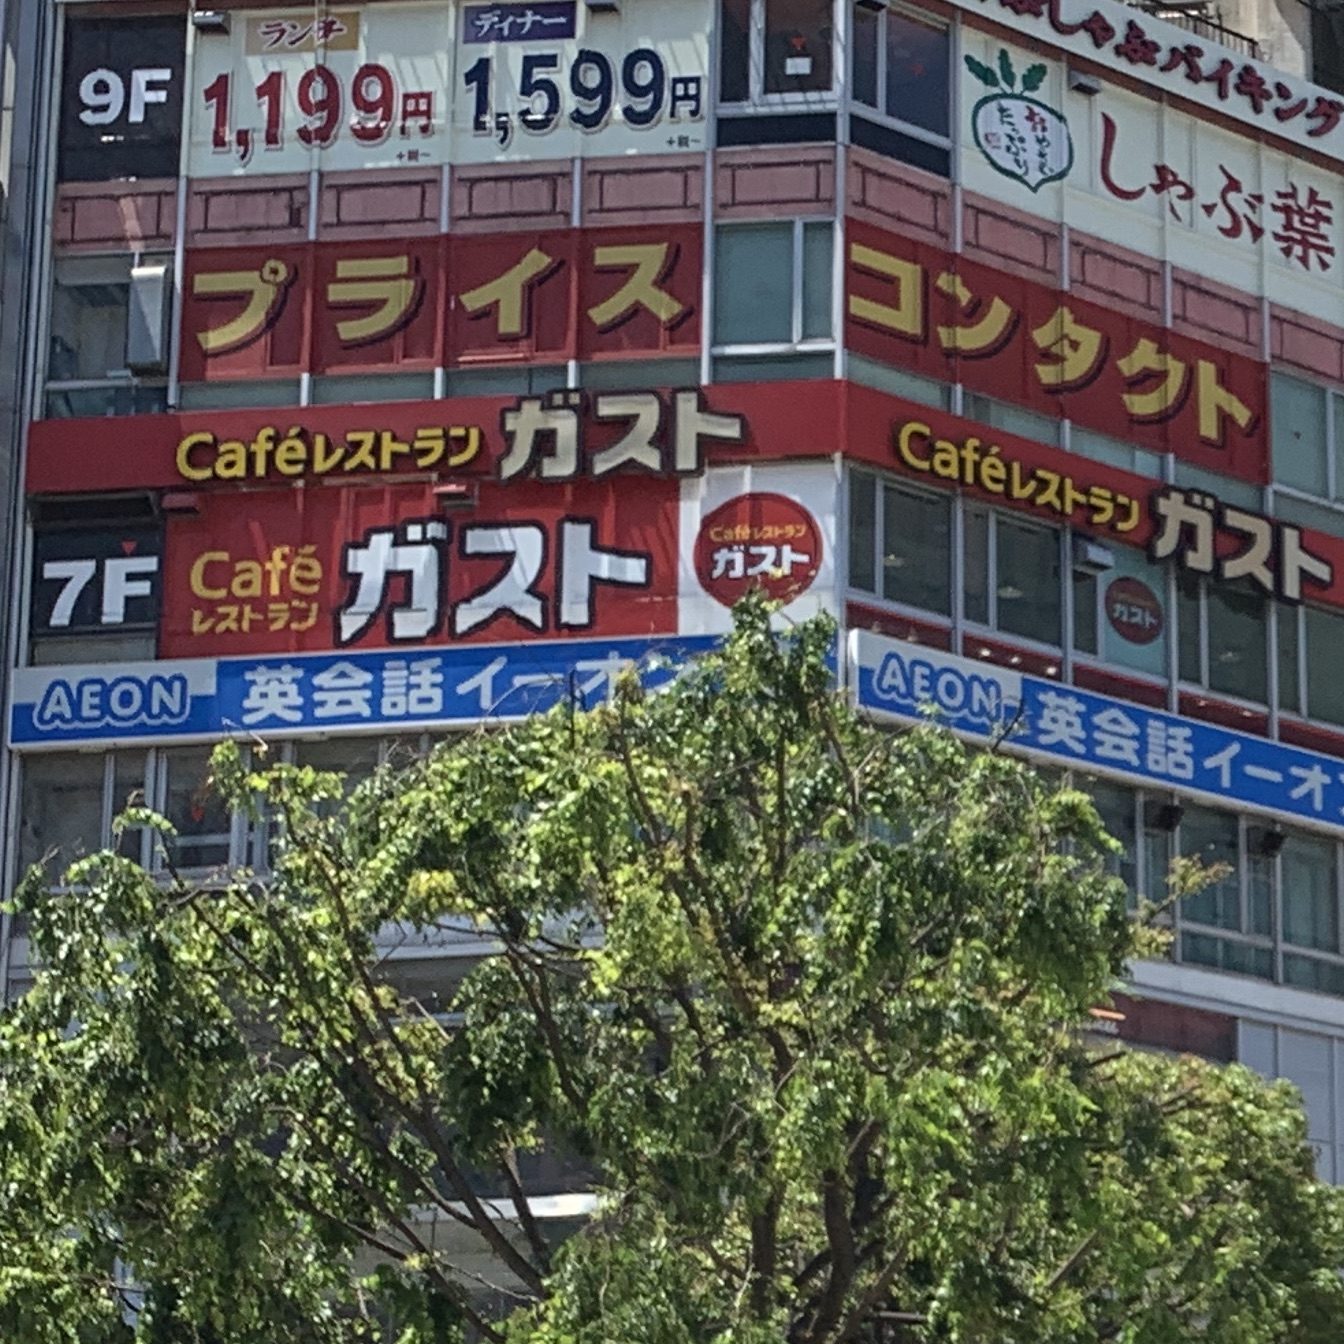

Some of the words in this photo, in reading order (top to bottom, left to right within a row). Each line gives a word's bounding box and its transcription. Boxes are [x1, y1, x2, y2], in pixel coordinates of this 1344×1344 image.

[475, 9, 567, 37] ディナー
[79, 68, 171, 125] 9F
[203, 63, 434, 162] 1,199円
[463, 48, 702, 150] 1,599円
[1101, 111, 1336, 272] しゃぶ葉
[193, 242, 685, 353] プライス
[849, 243, 1254, 443] コンタクト
[176, 424, 480, 482] Caféレストラン
[500, 390, 743, 481] ガスト
[899, 421, 1140, 532] Caféレストラン
[1154, 489, 1333, 600] ガスト
[43, 553, 160, 628] 7F
[189, 543, 324, 599] Café
[343, 519, 648, 643] ガスト
[710, 540, 811, 582] ガスト
[191, 599, 318, 636] レストラン
[1110, 601, 1159, 631] ガスト
[40, 680, 188, 726] AEON
[875, 654, 1003, 720] AEON
